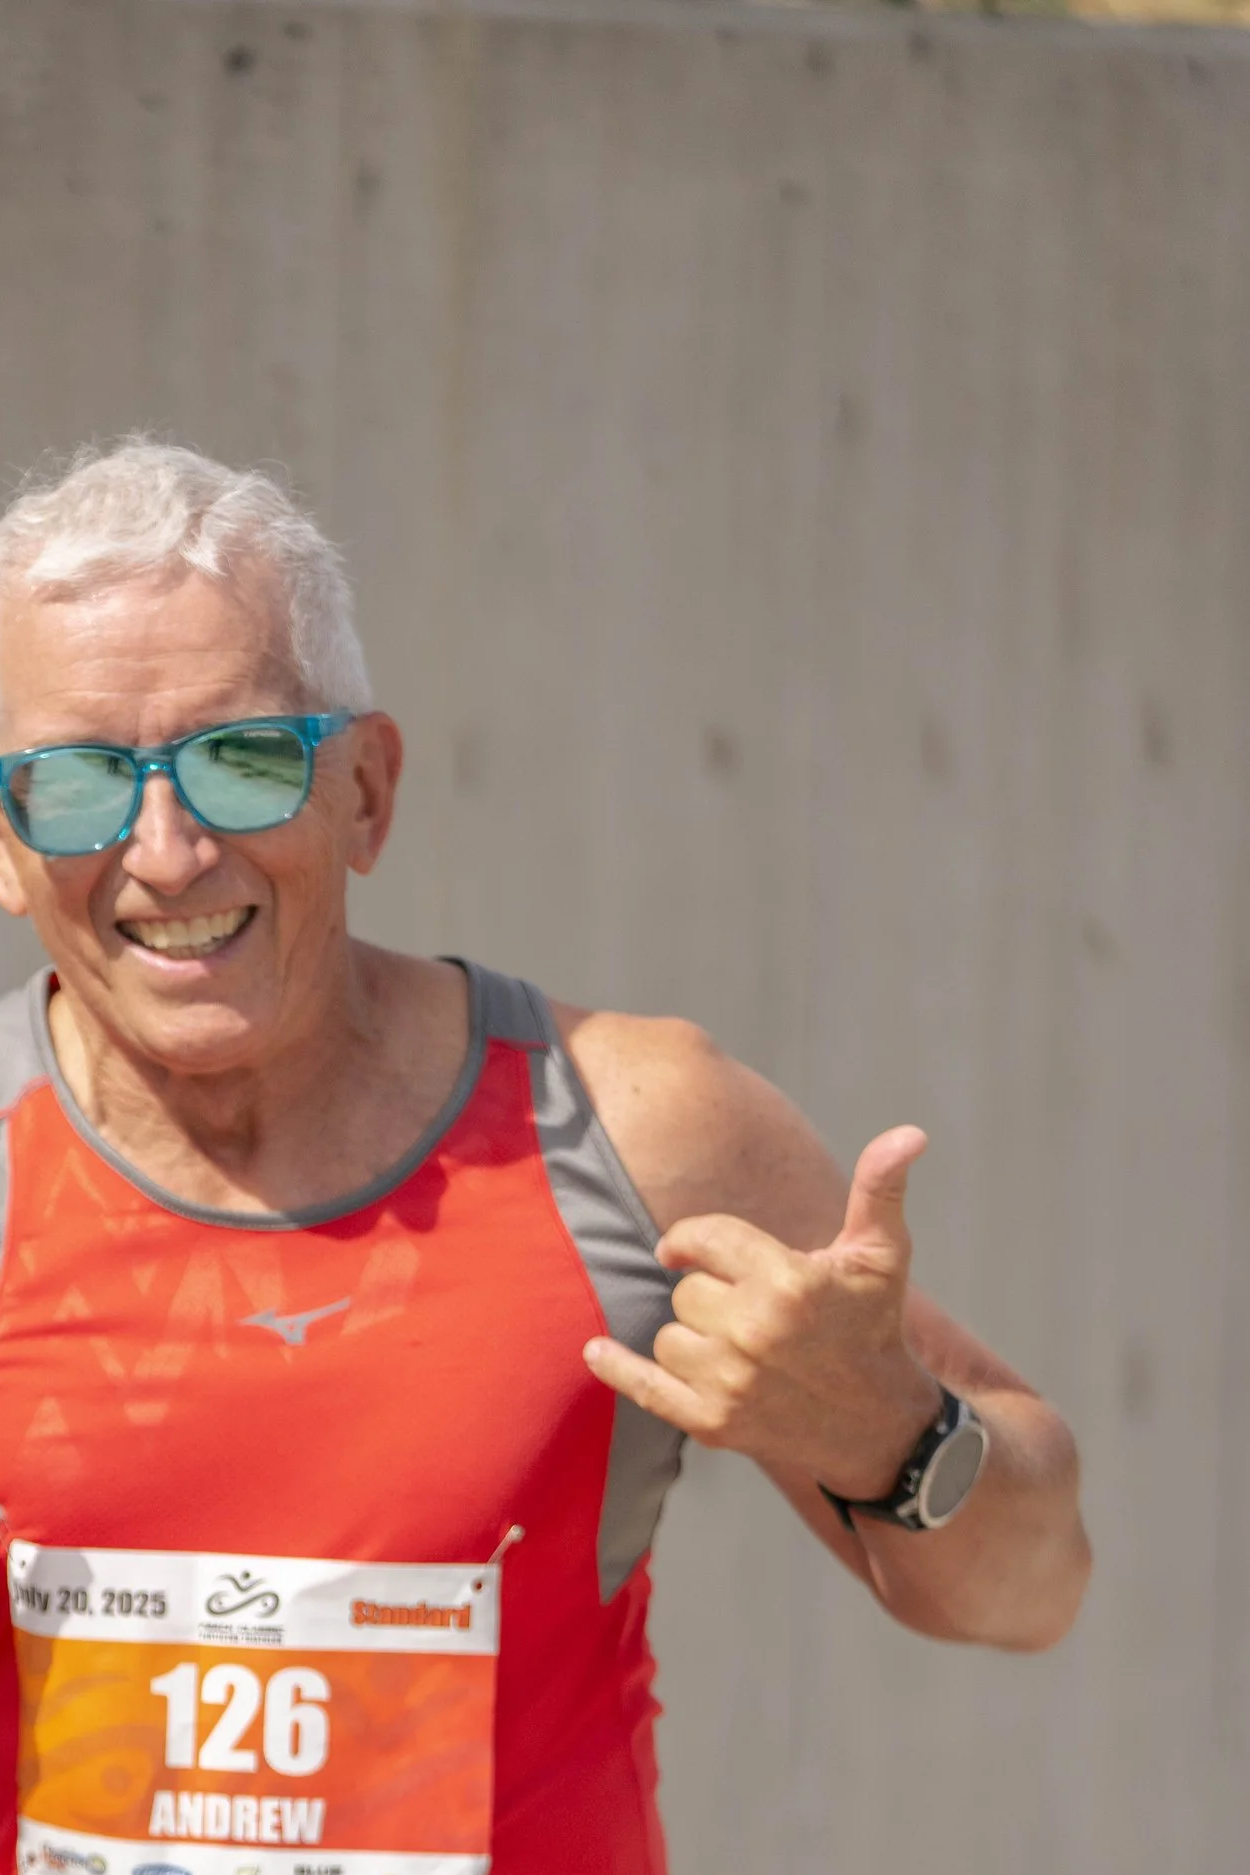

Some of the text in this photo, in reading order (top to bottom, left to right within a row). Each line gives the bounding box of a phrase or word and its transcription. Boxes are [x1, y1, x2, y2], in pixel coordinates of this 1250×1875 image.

[101, 1589, 168, 1617] 2025
[351, 1600, 471, 1629] Standard
[150, 1662, 330, 1776] 126
[149, 1790, 325, 1844] ANDREW
